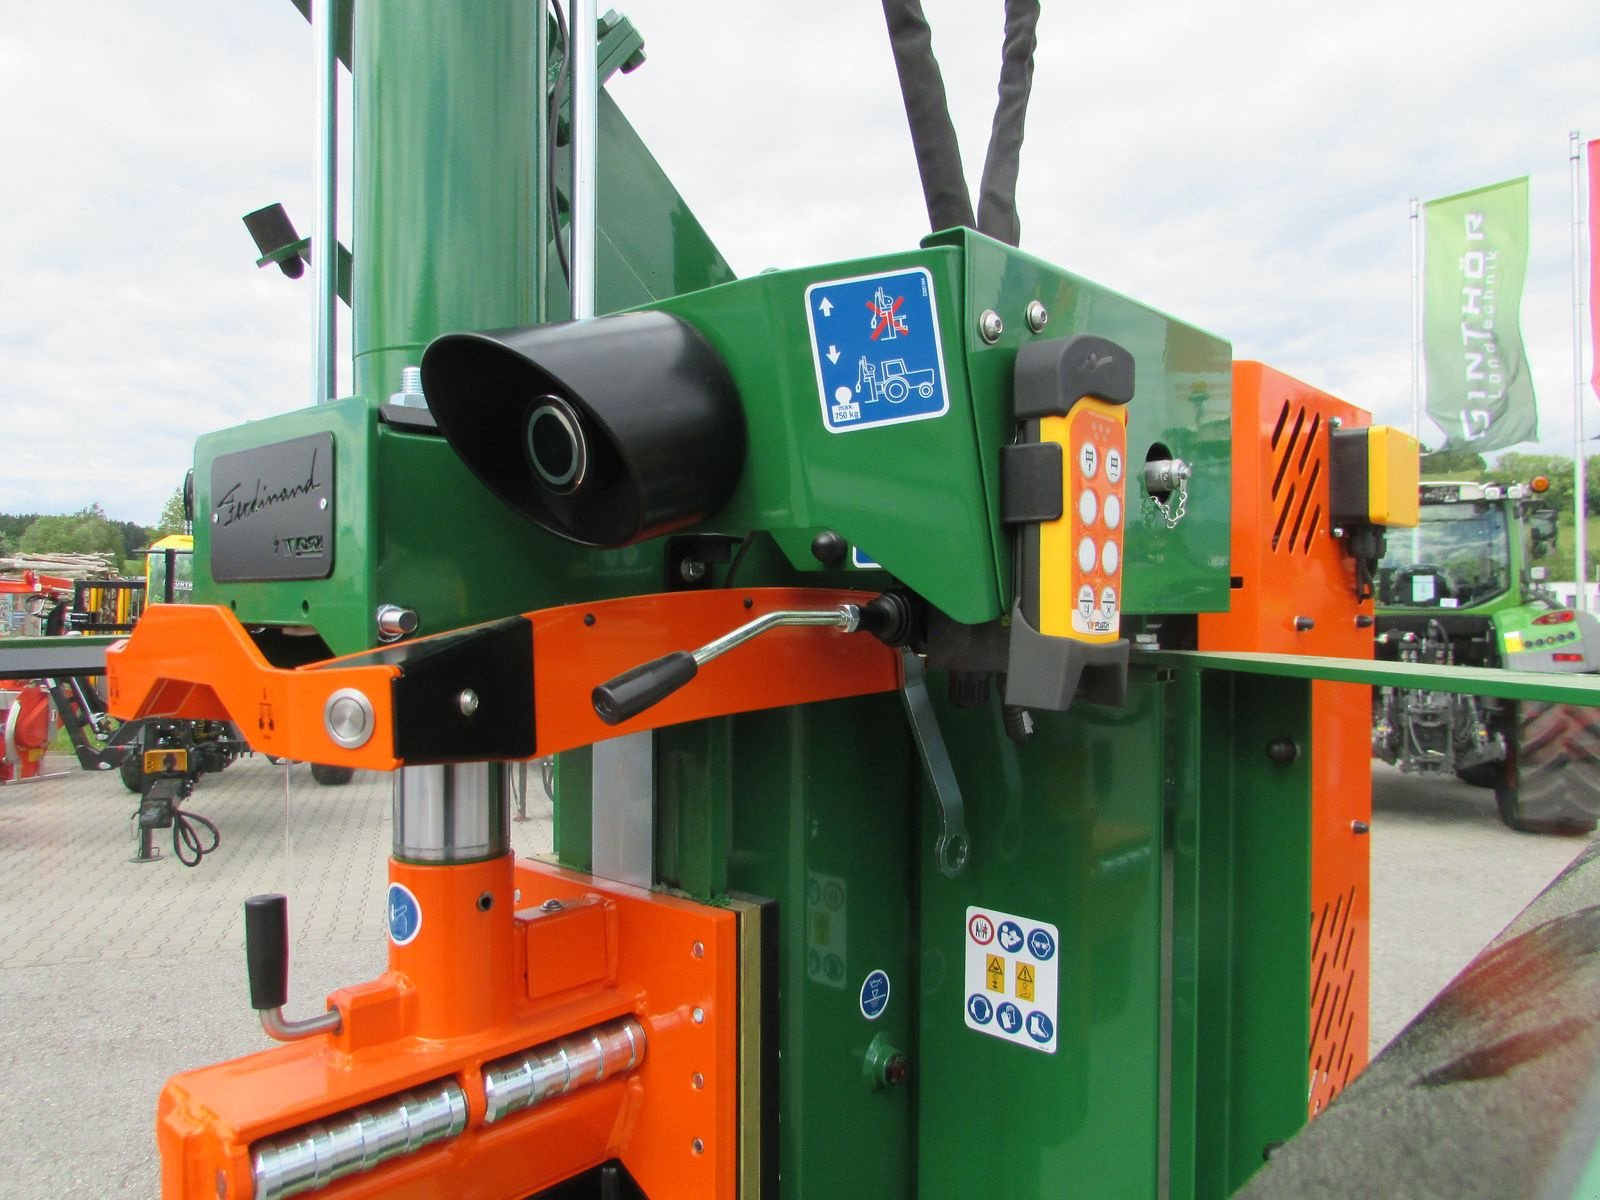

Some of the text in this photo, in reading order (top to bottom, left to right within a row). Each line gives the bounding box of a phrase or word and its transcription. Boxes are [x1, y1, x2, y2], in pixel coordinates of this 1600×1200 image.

[1459, 213, 1489, 441] GINTHÖR
[834, 410, 859, 420] 750 kg
[217, 448, 320, 526] Ferdinand
